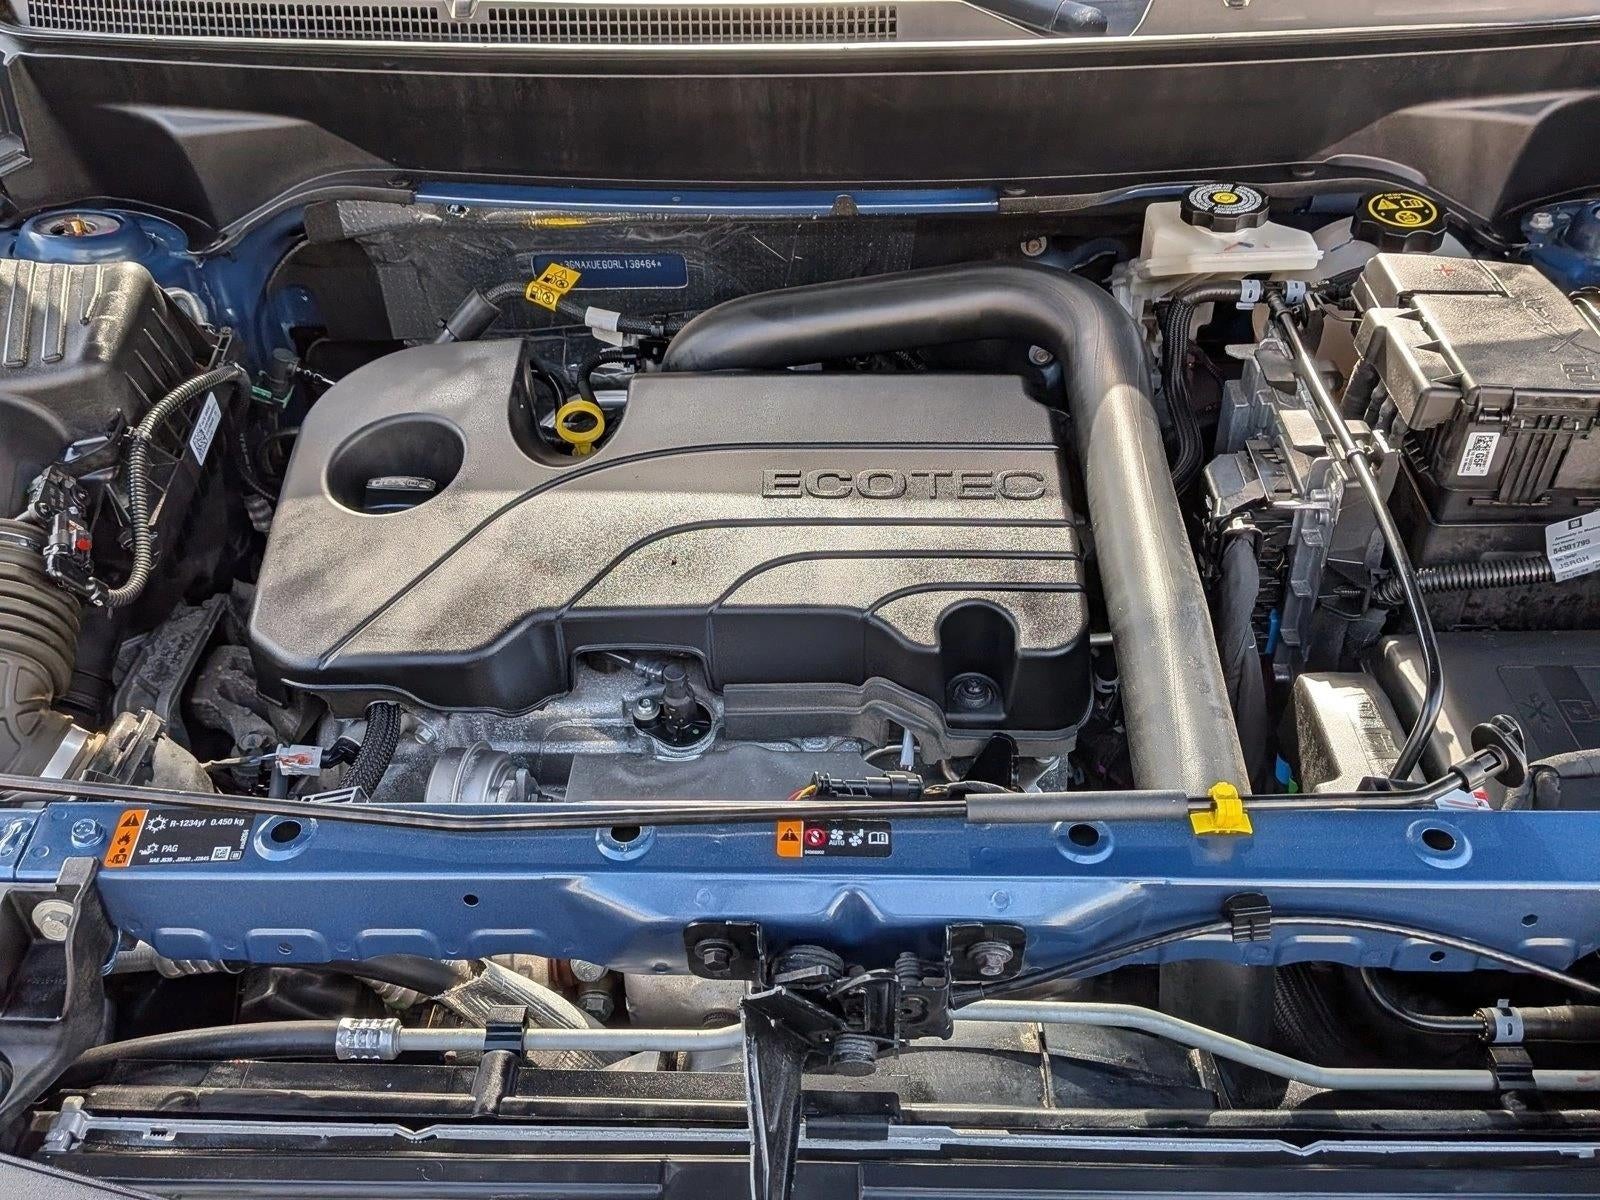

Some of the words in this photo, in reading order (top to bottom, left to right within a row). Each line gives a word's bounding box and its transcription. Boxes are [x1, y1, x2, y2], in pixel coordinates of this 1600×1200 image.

[762, 469, 1047, 500] ECOTEC
[169, 819, 207, 828] R-1234yf
[210, 818, 233, 826] 0.450
[233, 818, 245, 826] kg
[161, 844, 179, 853] PAG
